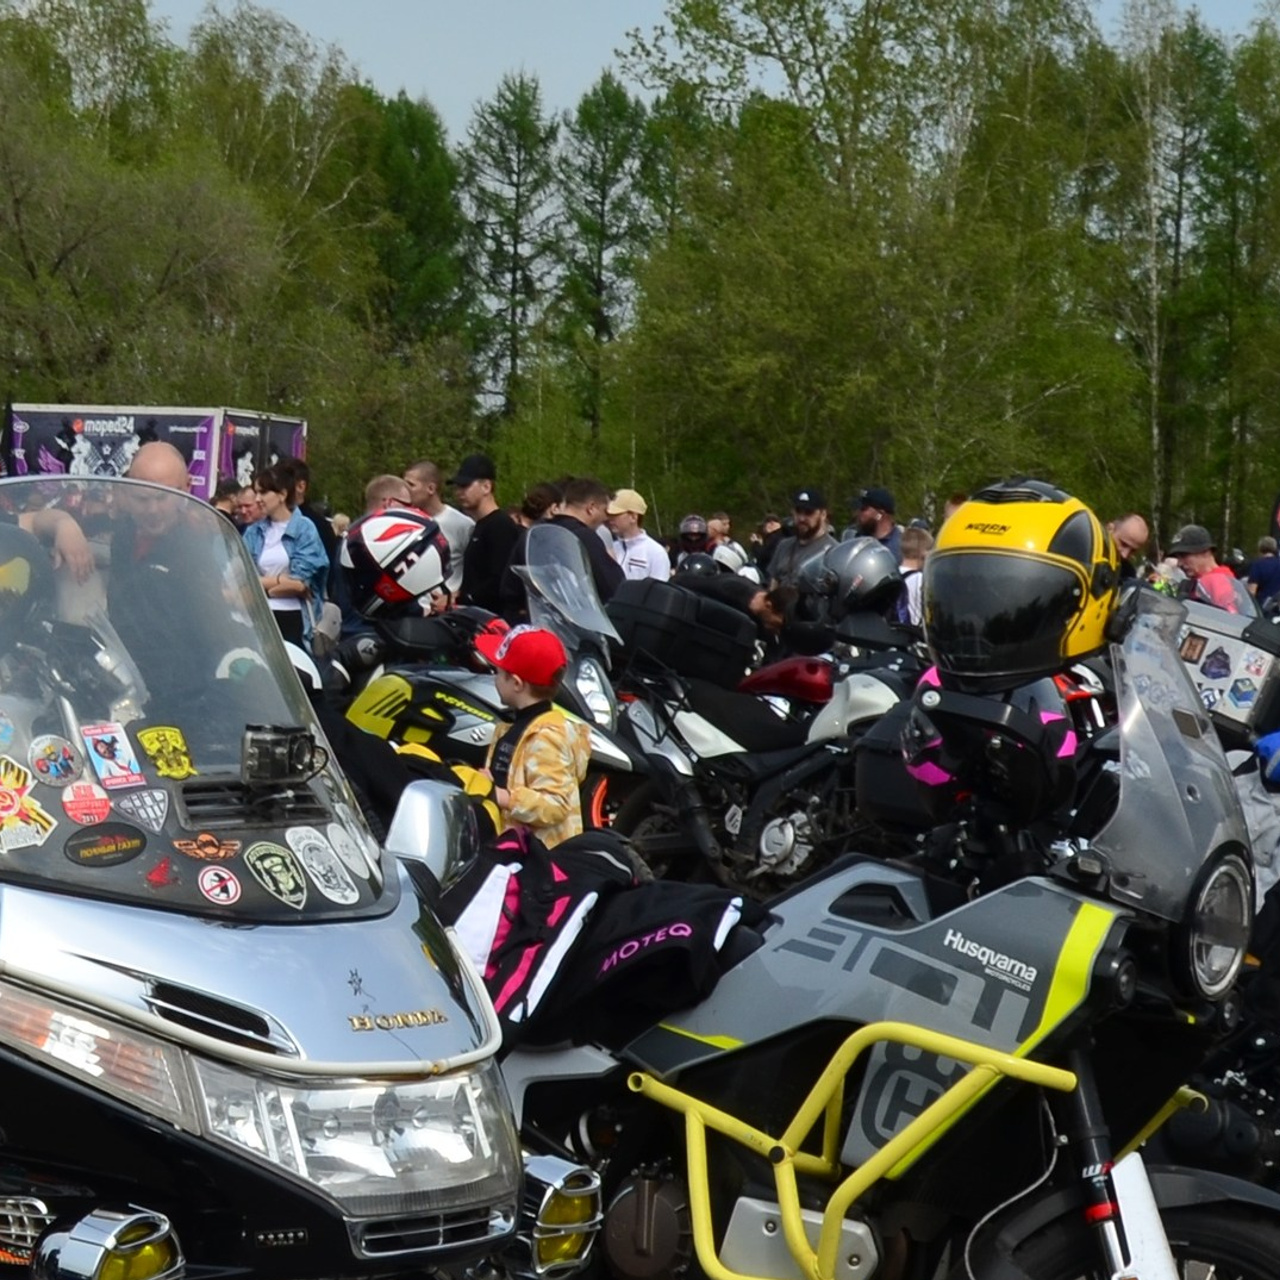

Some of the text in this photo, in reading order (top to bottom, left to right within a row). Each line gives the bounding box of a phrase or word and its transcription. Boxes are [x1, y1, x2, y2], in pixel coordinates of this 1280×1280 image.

[83, 416, 135, 436] moped24
[596, 922, 693, 978] MOTEQ
[943, 928, 1038, 983] Husqvarna
[984, 967, 1032, 993] MOTORCYCLES
[347, 1008, 448, 1033] HONDA
